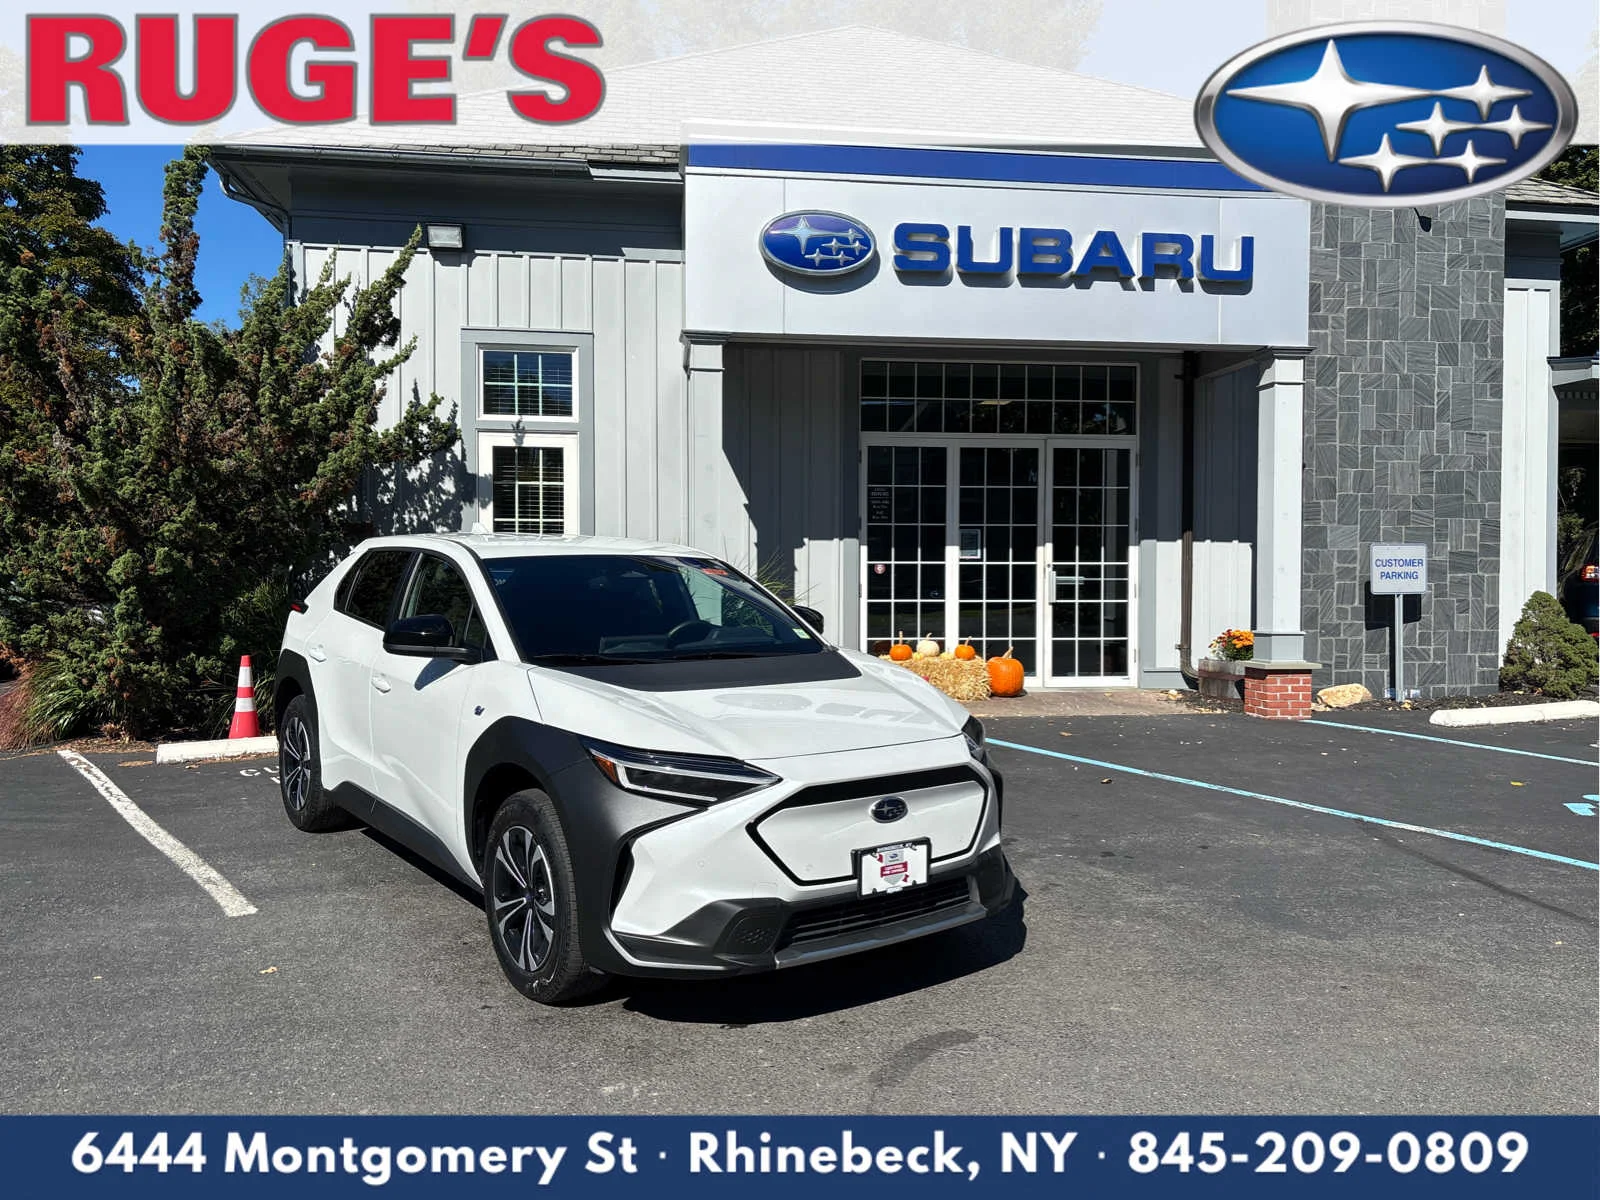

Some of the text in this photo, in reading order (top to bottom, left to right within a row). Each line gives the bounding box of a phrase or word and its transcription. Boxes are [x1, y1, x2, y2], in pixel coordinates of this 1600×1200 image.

[893, 222, 1255, 283] SUBARU
[1374, 558, 1424, 568] CUSTOMER
[1380, 571, 1419, 580] PARKING
